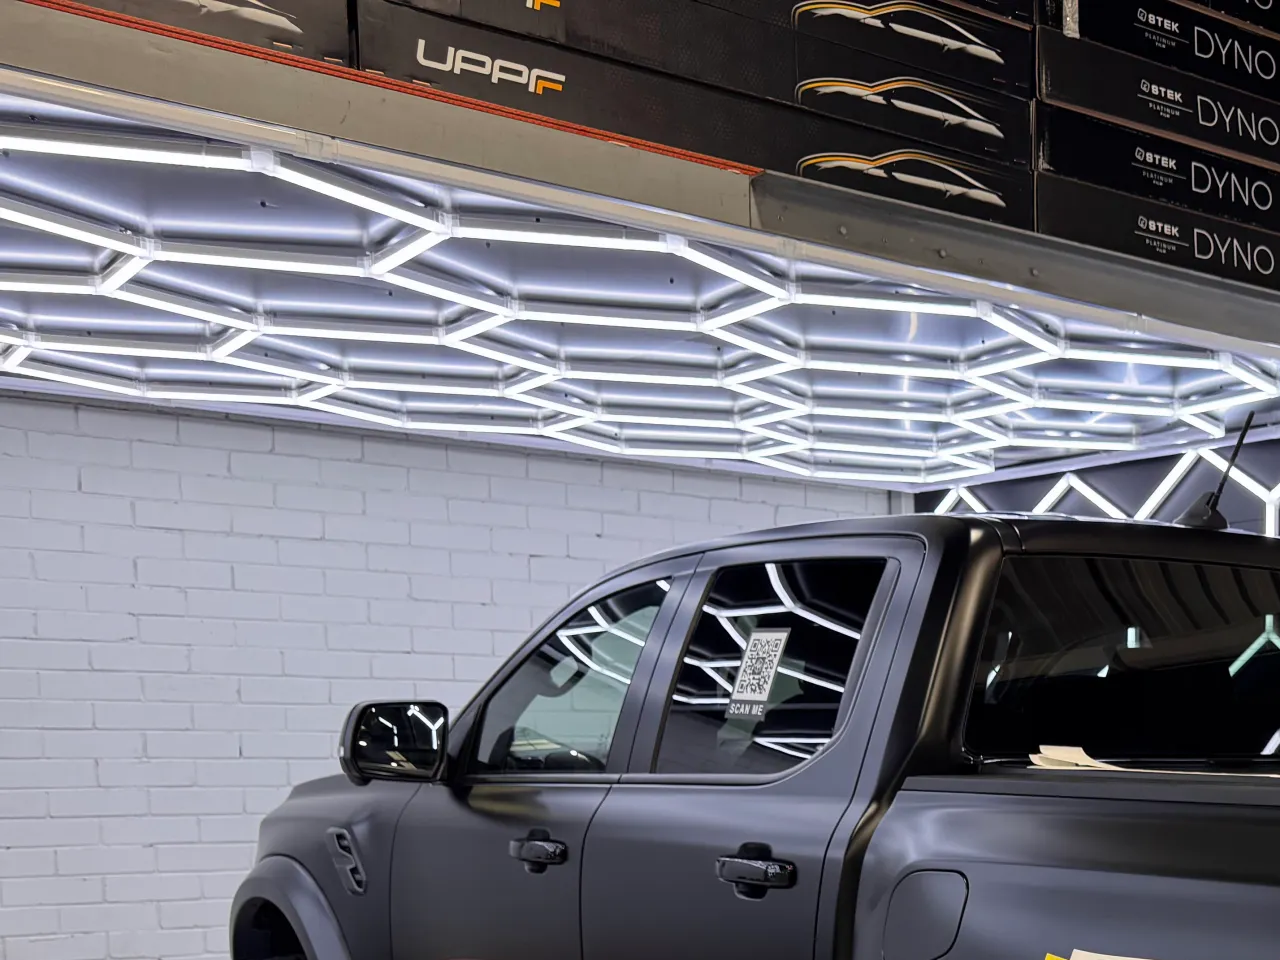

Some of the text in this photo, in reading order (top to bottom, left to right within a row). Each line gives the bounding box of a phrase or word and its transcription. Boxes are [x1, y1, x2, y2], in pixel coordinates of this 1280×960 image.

[1148, 14, 1180, 33] STEK
[1194, 26, 1276, 80] DYNO
[416, 38, 566, 95] UPPF
[1151, 85, 1183, 103] STEK
[1149, 103, 1180, 116] PLATINUM
[1197, 95, 1279, 146] DYNO
[1145, 152, 1177, 170] STEK
[1191, 161, 1273, 211] DYNO
[1149, 220, 1180, 237] STEK
[1193, 228, 1275, 275] DYNO
[729, 704, 764, 715] SCAN ME
